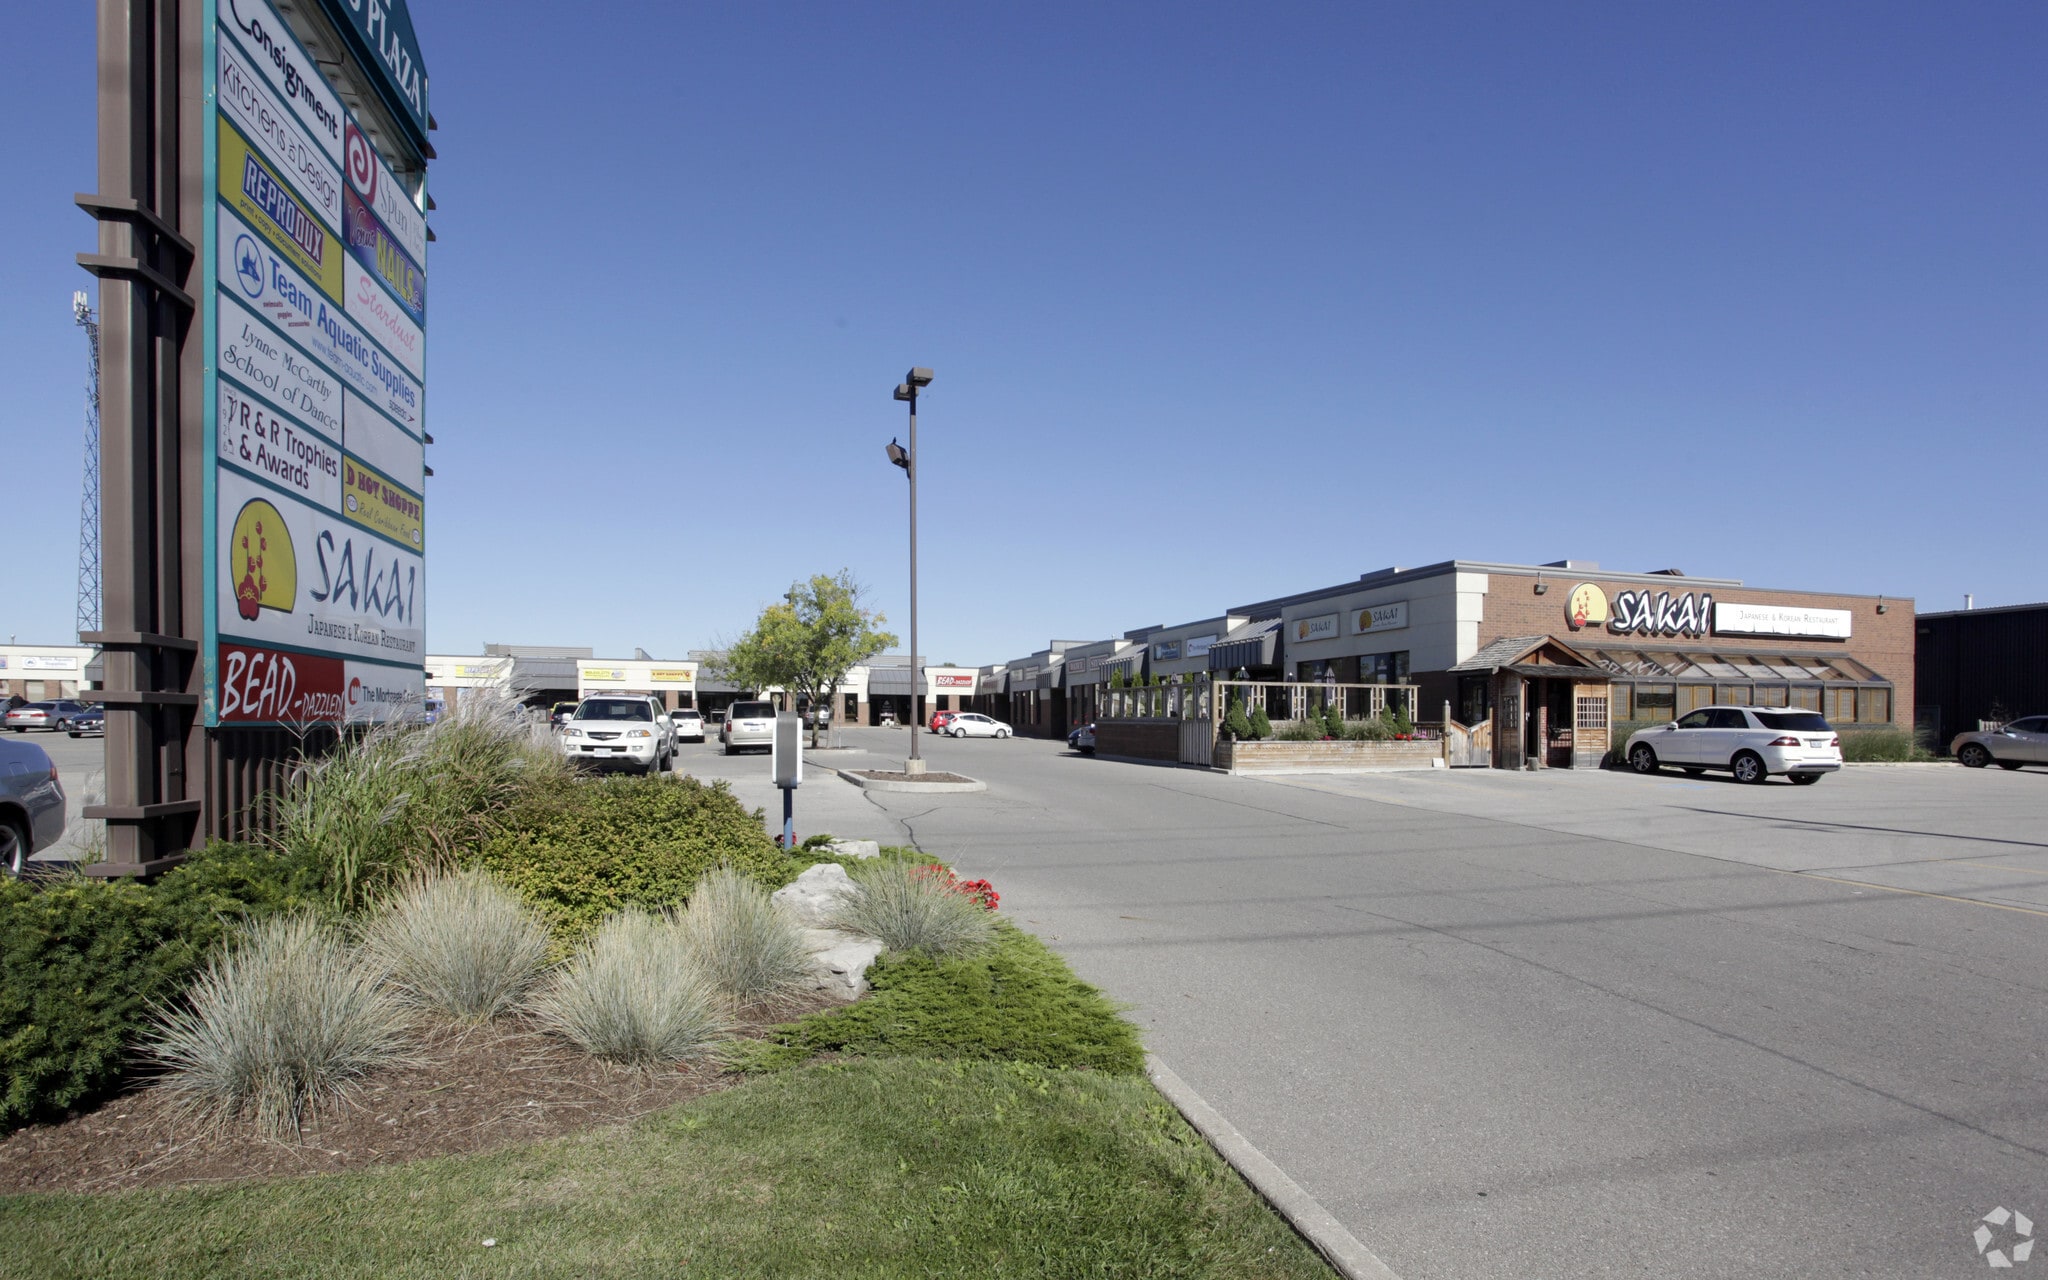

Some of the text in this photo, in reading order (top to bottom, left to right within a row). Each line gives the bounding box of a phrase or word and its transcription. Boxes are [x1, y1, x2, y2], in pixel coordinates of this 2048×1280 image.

[366, 0, 422, 117] PLAZA
[222, 55, 286, 152] Kitchens
[298, 144, 338, 212] Design
[245, 159, 322, 262] REPRODUX
[268, 255, 313, 320] Team
[317, 301, 369, 368] Aquatic
[371, 350, 416, 409] Supplies
[357, 275, 416, 352] Stardust
[223, 344, 338, 431] School of Dance
[241, 322, 332, 402] Lynne McCarthy
[239, 433, 309, 490] & Awards
[241, 401, 338, 478] R & R Trophies
[358, 471, 380, 500] HOT
[382, 485, 420, 522] SHOPPE
[1612, 589, 1712, 635] SAKAI
[362, 685, 375, 703] The
